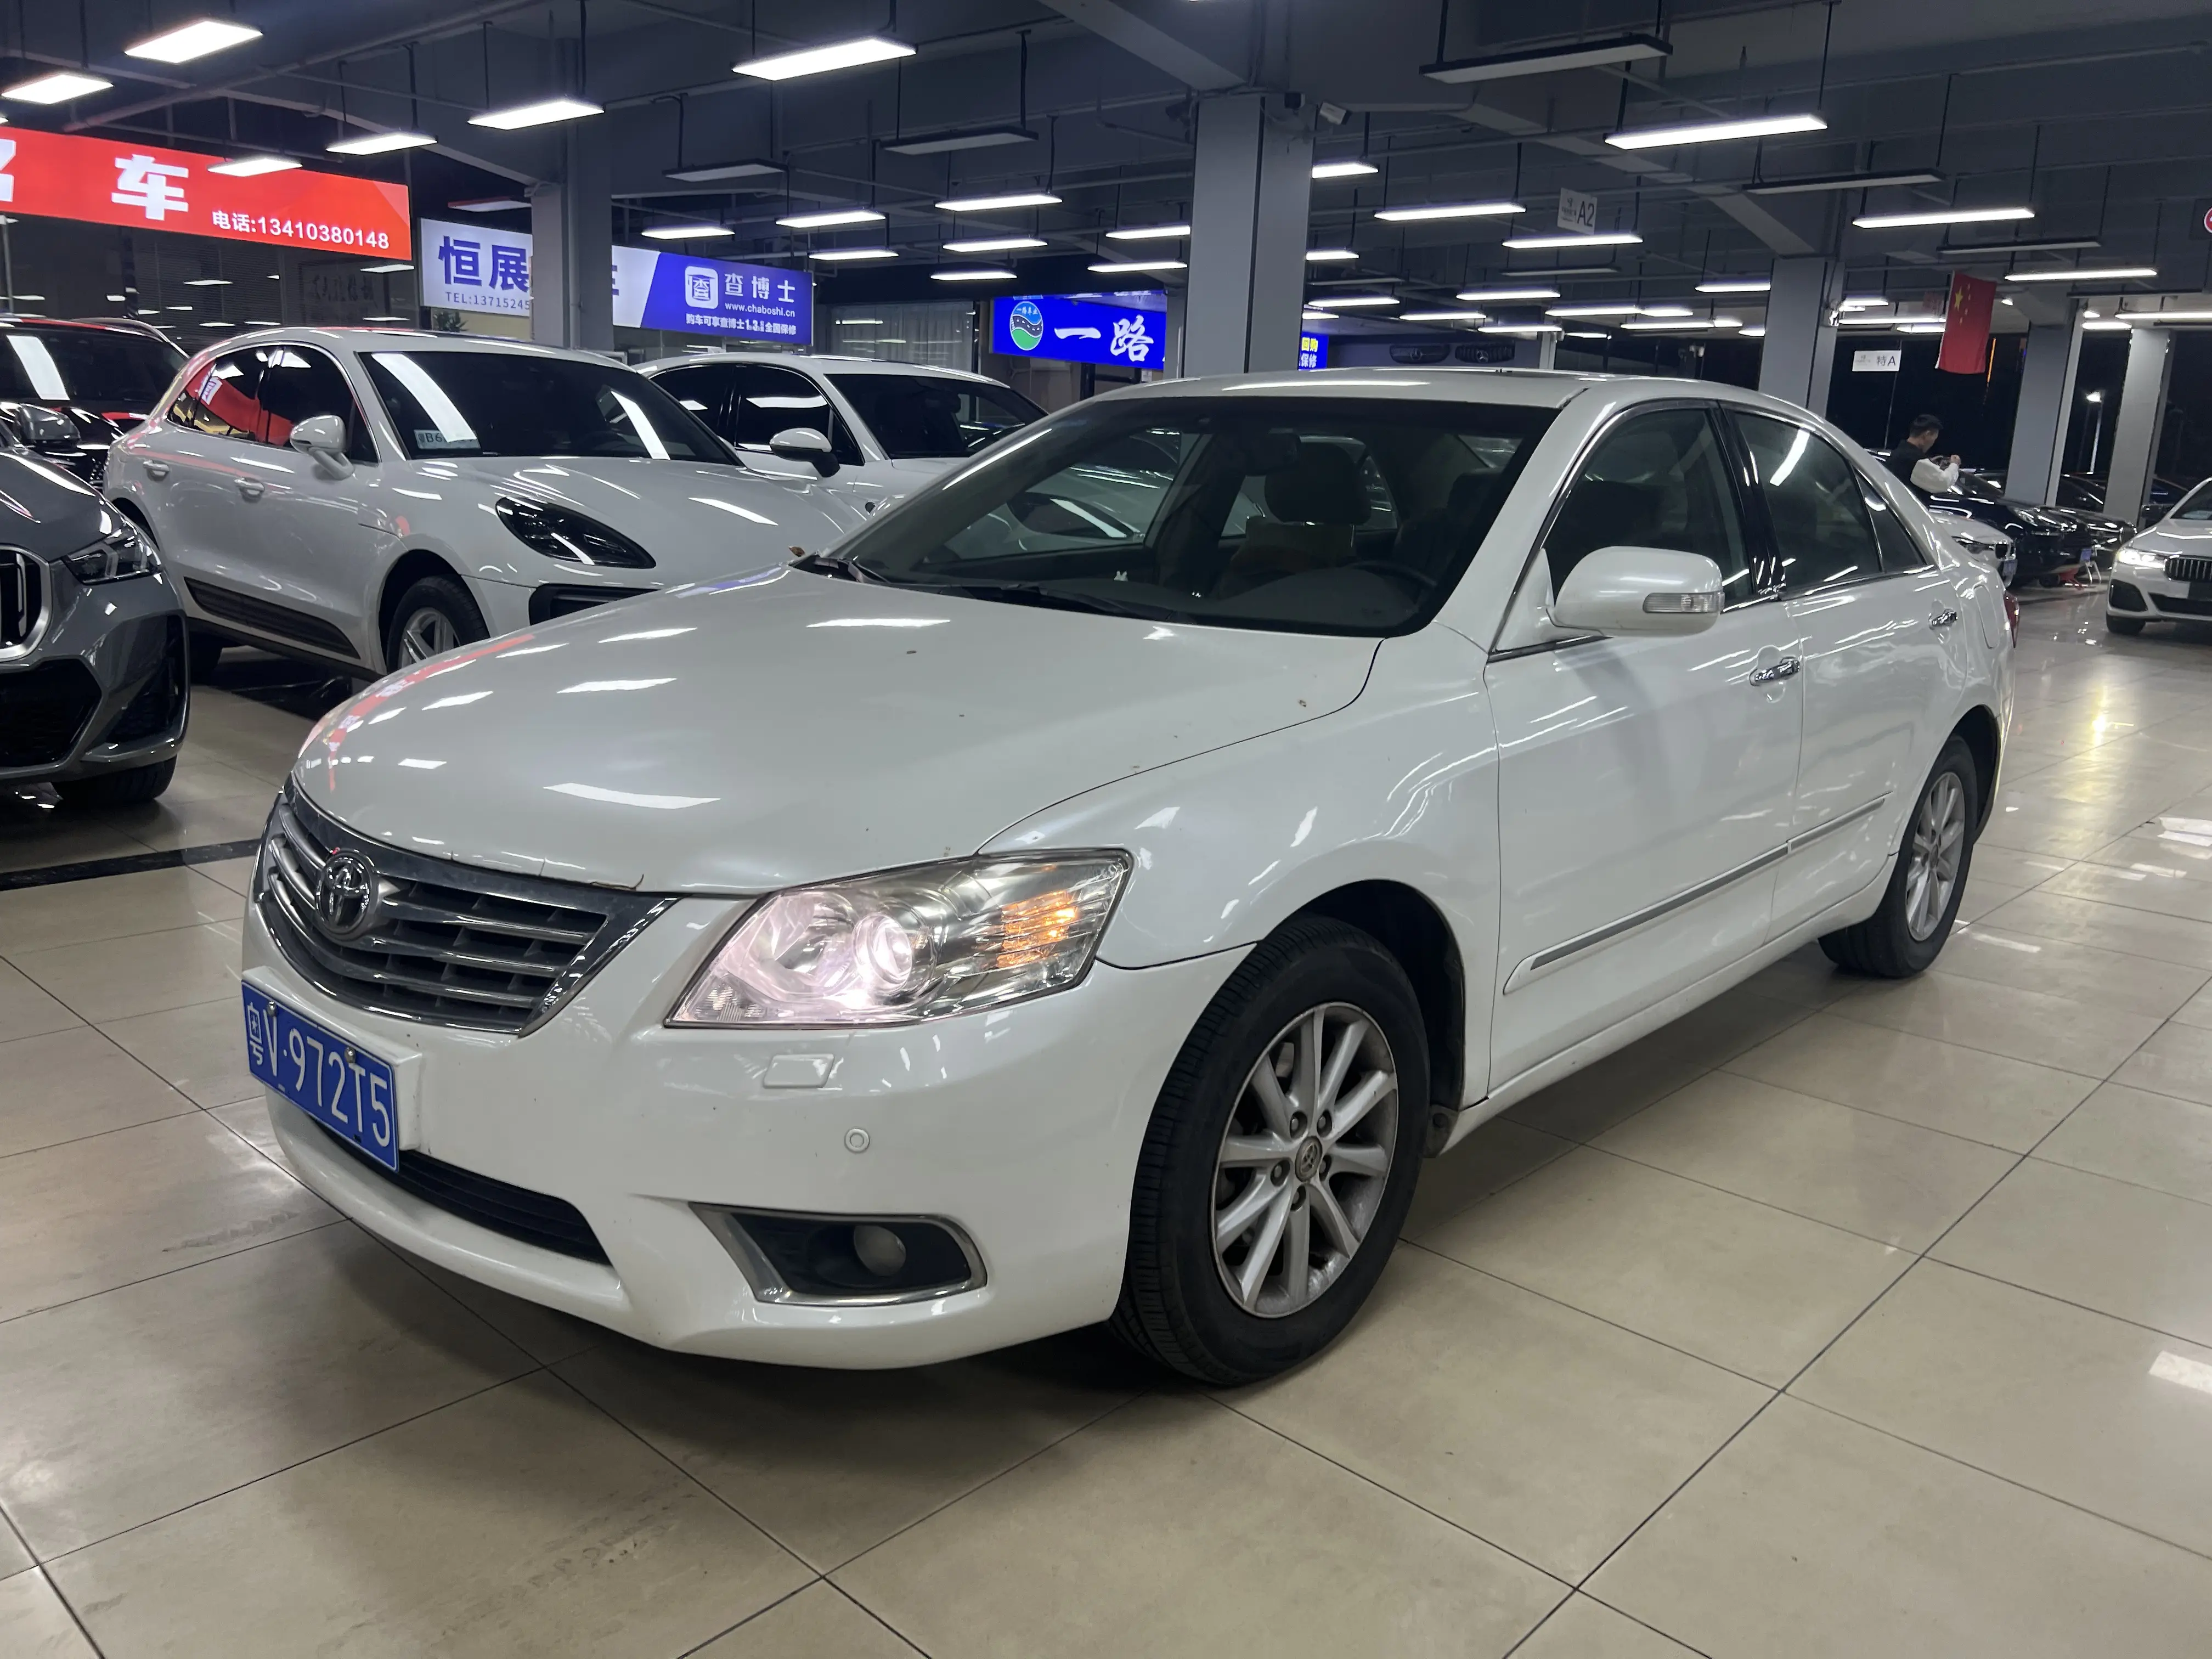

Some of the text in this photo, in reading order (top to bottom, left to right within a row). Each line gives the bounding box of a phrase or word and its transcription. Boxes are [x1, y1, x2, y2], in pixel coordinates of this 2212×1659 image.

[212, 210, 390, 250] 电话:13410380148
[1577, 200, 1595, 228] A2
[438, 235, 530, 293] 恒展
[724, 273, 795, 303] 查博士
[724, 302, 795, 318] www.chaboshi.cn
[1054, 314, 1154, 362] 一路
[247, 1002, 391, 1148] 粤V·972T5
